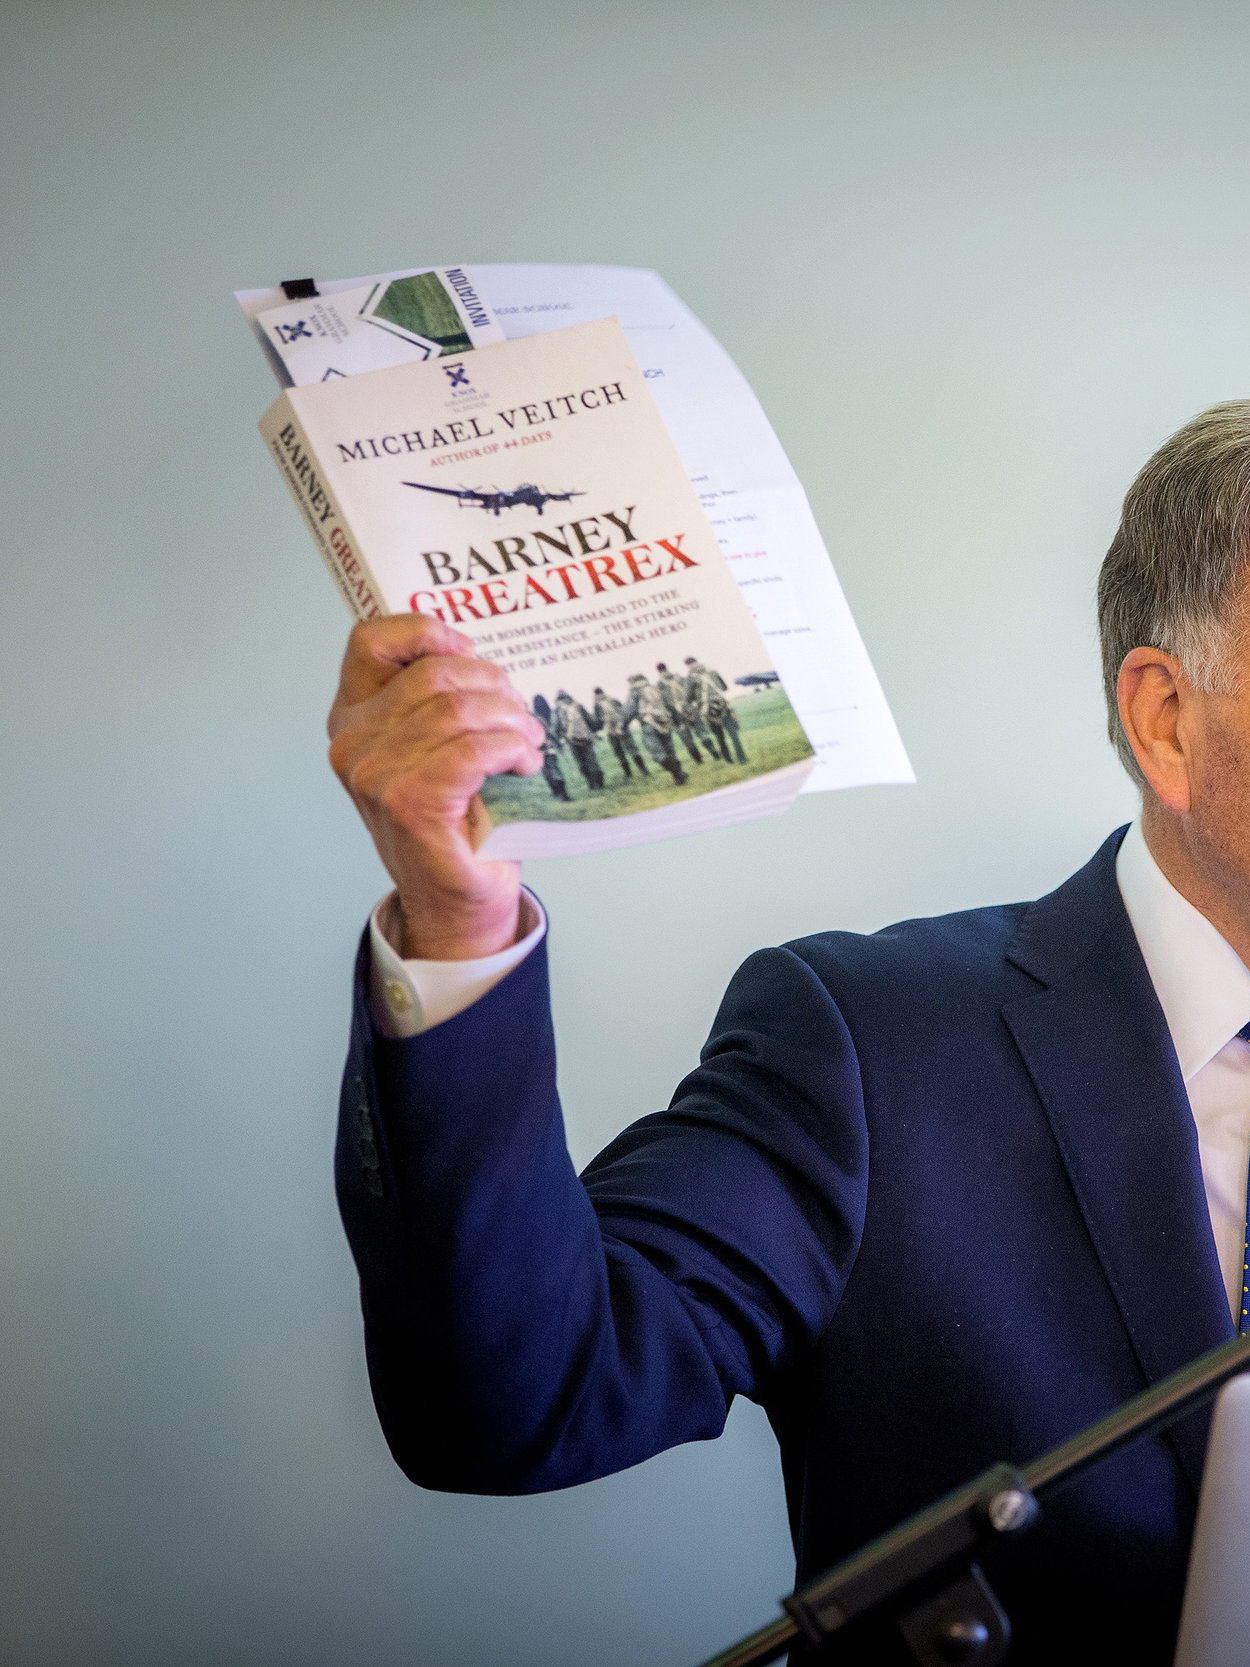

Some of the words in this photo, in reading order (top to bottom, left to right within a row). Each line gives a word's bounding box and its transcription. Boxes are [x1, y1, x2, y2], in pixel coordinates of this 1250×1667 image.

[444, 268, 490, 328] INVITATION
[337, 417, 494, 463] MICHAEL
[497, 382, 627, 430] VEITCH
[430, 447, 482, 467] AUTHOR
[482, 443, 500, 455] OF
[503, 438, 519, 451] 44
[520, 430, 553, 447] DAYS
[279, 422, 335, 523] BARNEY
[420, 505, 640, 586] BARNEY
[409, 533, 701, 624] GREATREX
[497, 623, 553, 642] BOMBER
[551, 602, 628, 631] COMMAND
[629, 598, 648, 613] TO
[649, 588, 681, 608] THE
[507, 630, 590, 656] RESISTANCE
[602, 619, 633, 636] THE
[634, 599, 700, 625] STIRRING
[518, 657, 537, 670] OF
[540, 655, 559, 667] AN
[560, 633, 647, 662] AUSTRALIAN
[649, 620, 688, 640] HERO
